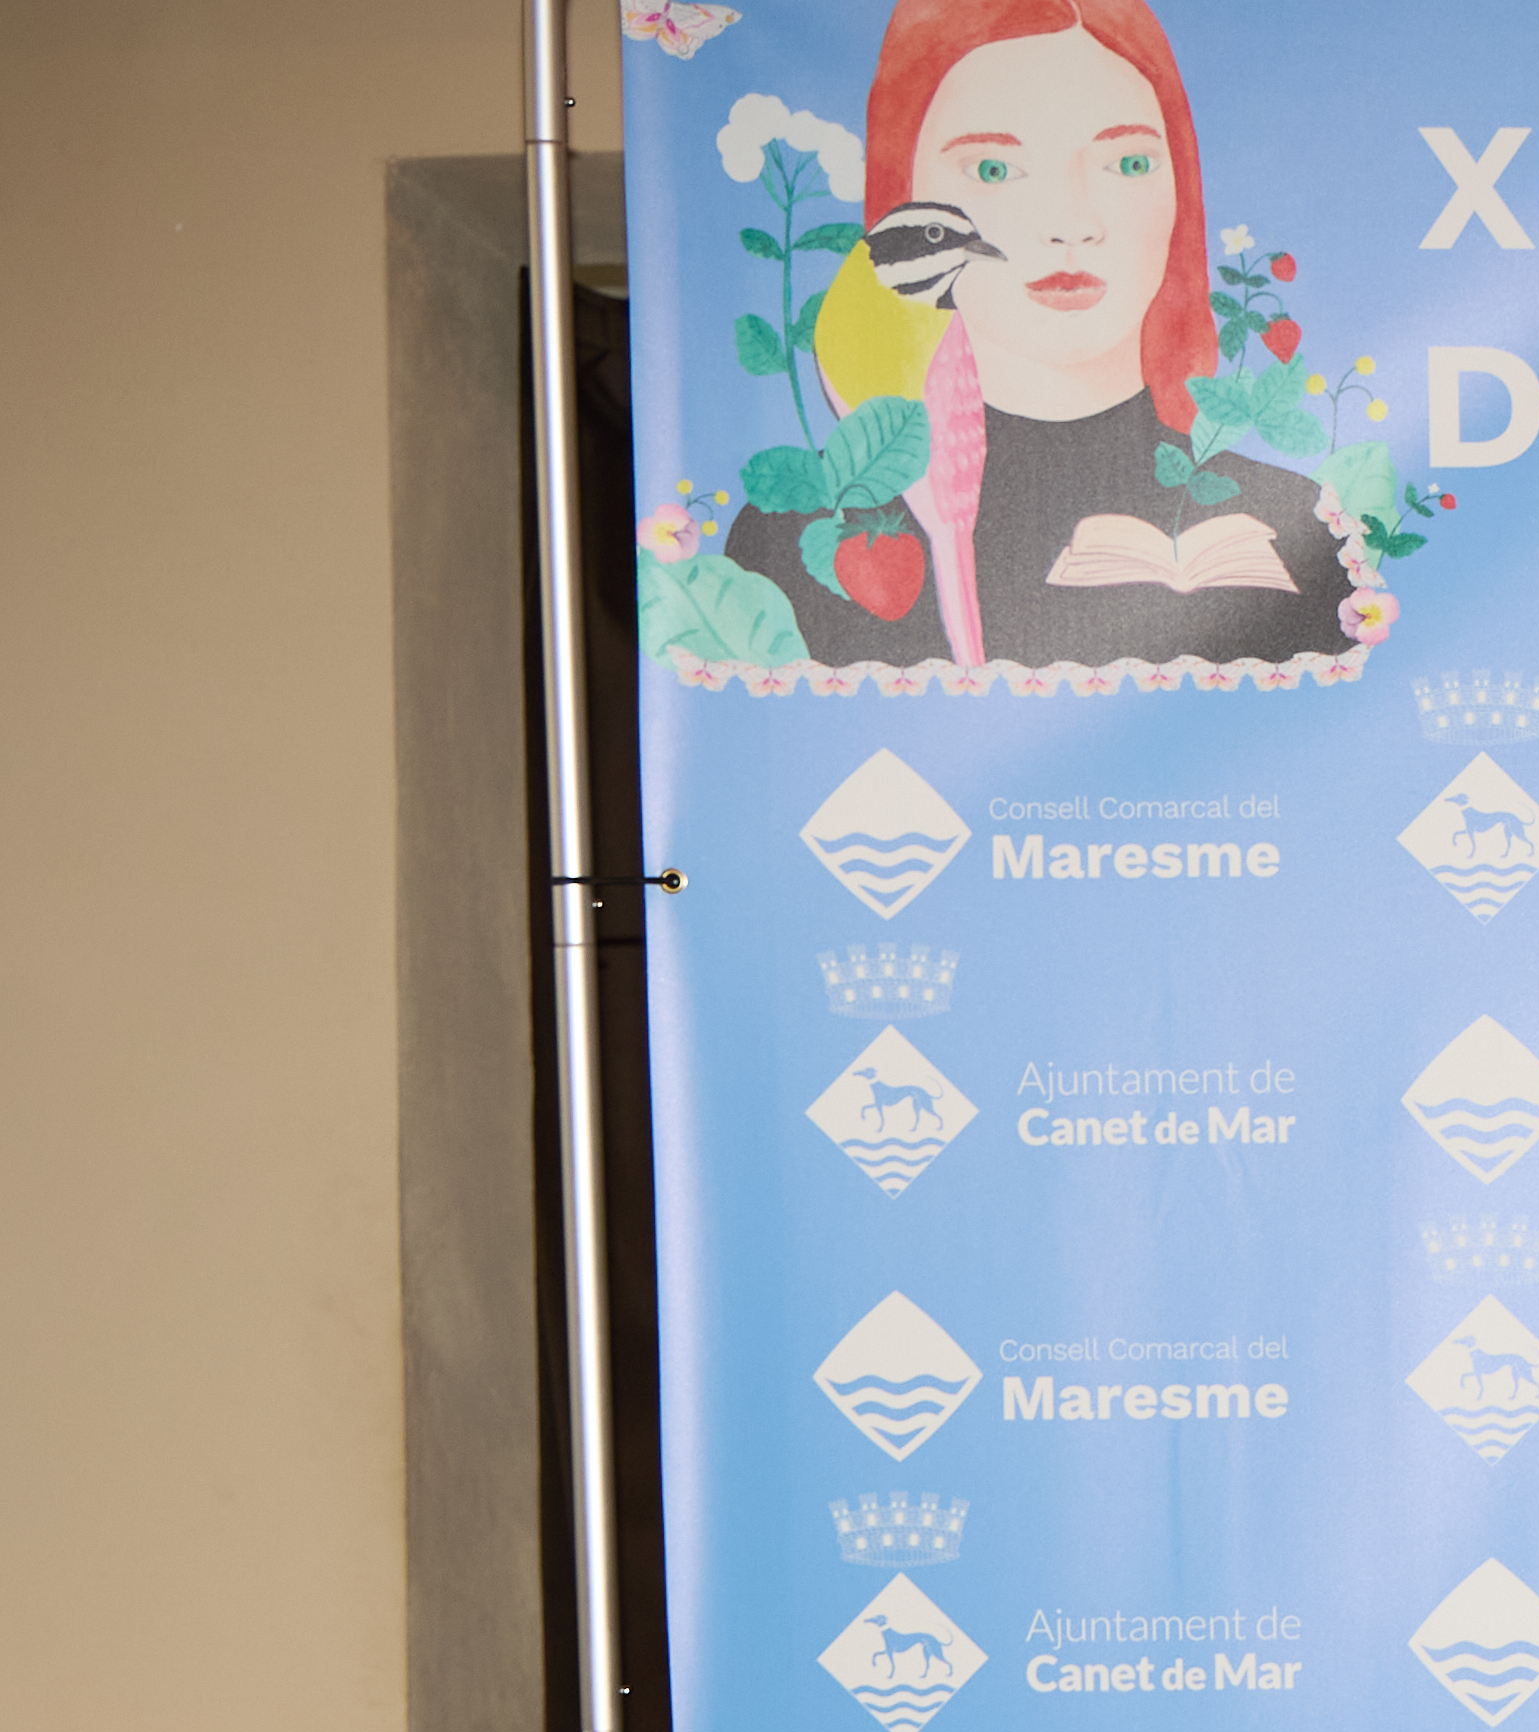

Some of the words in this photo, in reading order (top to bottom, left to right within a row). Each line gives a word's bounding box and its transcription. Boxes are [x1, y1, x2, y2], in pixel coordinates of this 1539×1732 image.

[989, 796, 1090, 820] Consell
[1098, 795, 1229, 820] Comarcal
[1239, 795, 1279, 817] del
[991, 833, 1281, 880] Maresme
[1016, 1061, 1240, 1104] Ajuntament
[1249, 1059, 1296, 1094] de
[1016, 1106, 1148, 1147] Canet
[1154, 1111, 1200, 1146] de
[1207, 1105, 1297, 1145] Mar
[1025, 1608, 1246, 1651] Ajuntament
[1256, 1606, 1302, 1640] de
[1025, 1653, 1156, 1693] Canet
[1161, 1657, 1207, 1692] de
[1214, 1652, 1303, 1691] Mar
